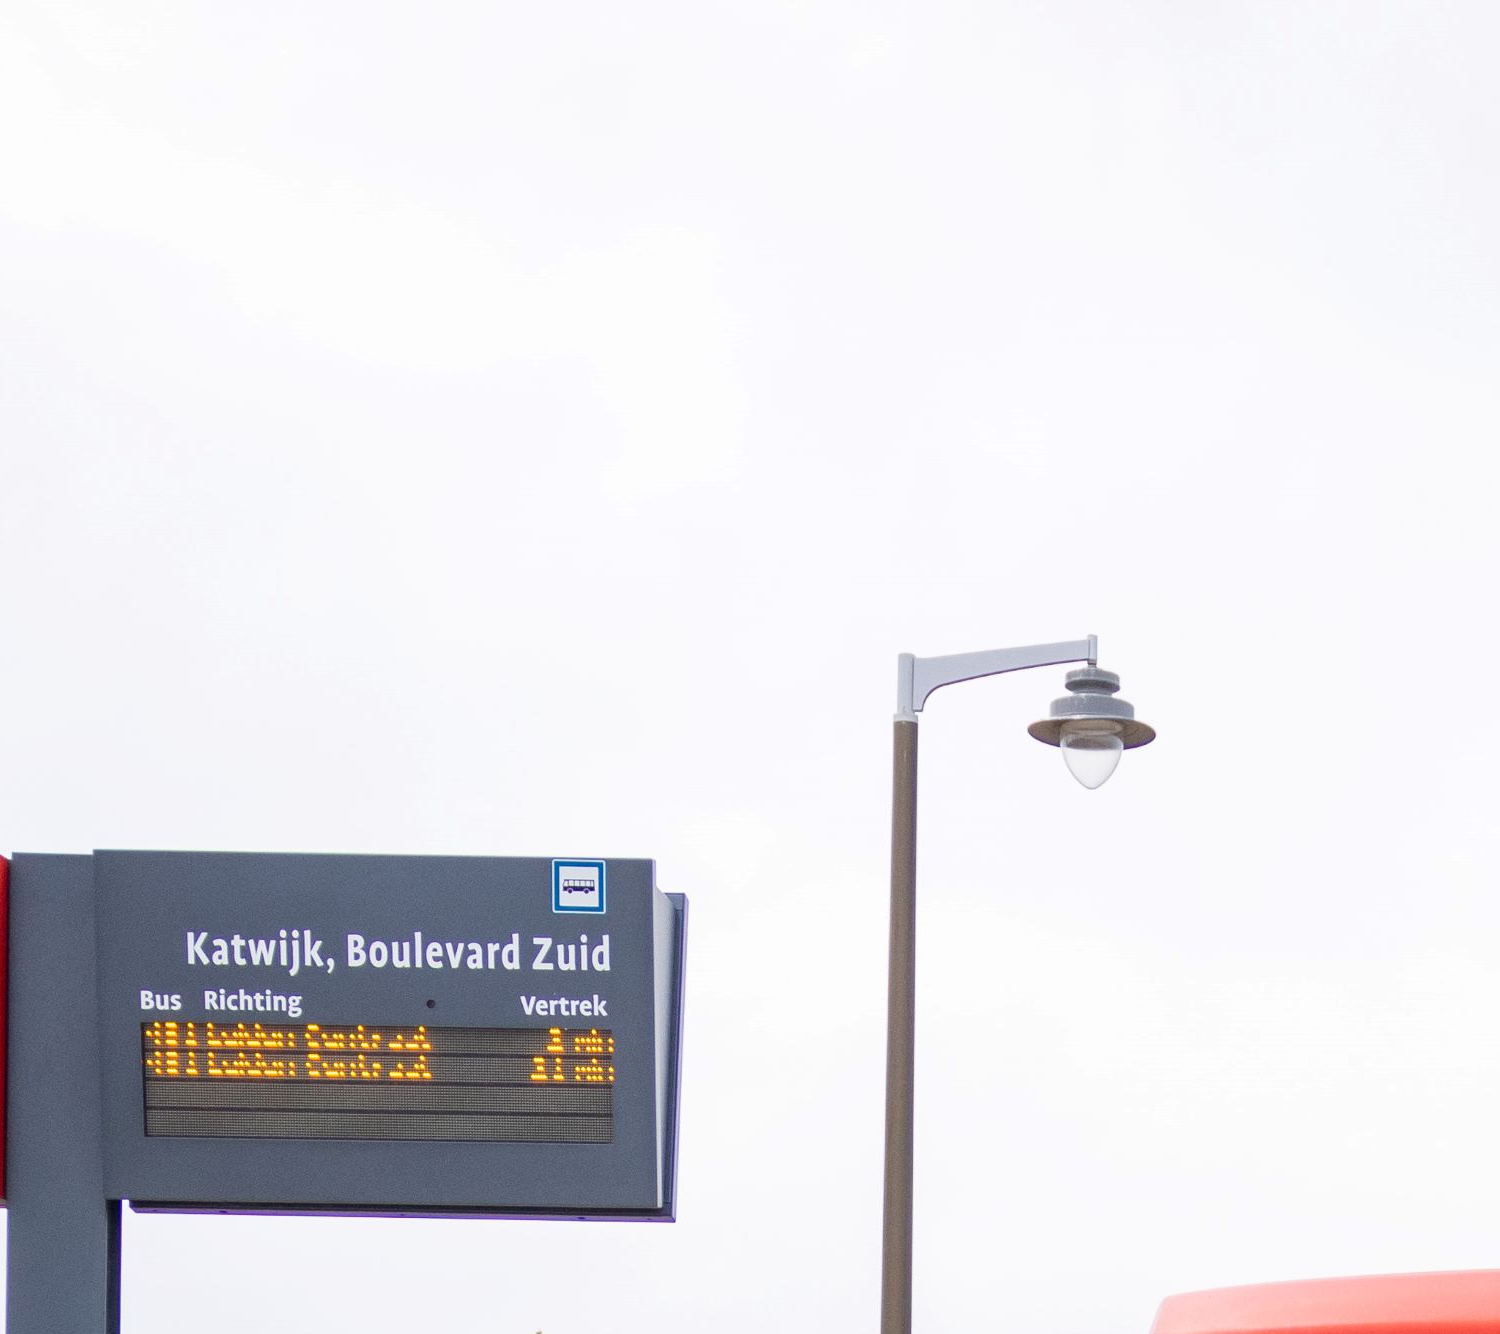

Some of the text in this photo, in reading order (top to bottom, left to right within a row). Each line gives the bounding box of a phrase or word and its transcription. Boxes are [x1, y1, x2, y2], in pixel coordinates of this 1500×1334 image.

[186, 929, 611, 976] Katwijk, Boulevard Zuid
[140, 989, 182, 1011] Bus
[204, 989, 303, 1018] Richting
[520, 994, 608, 1017] Vertrek
